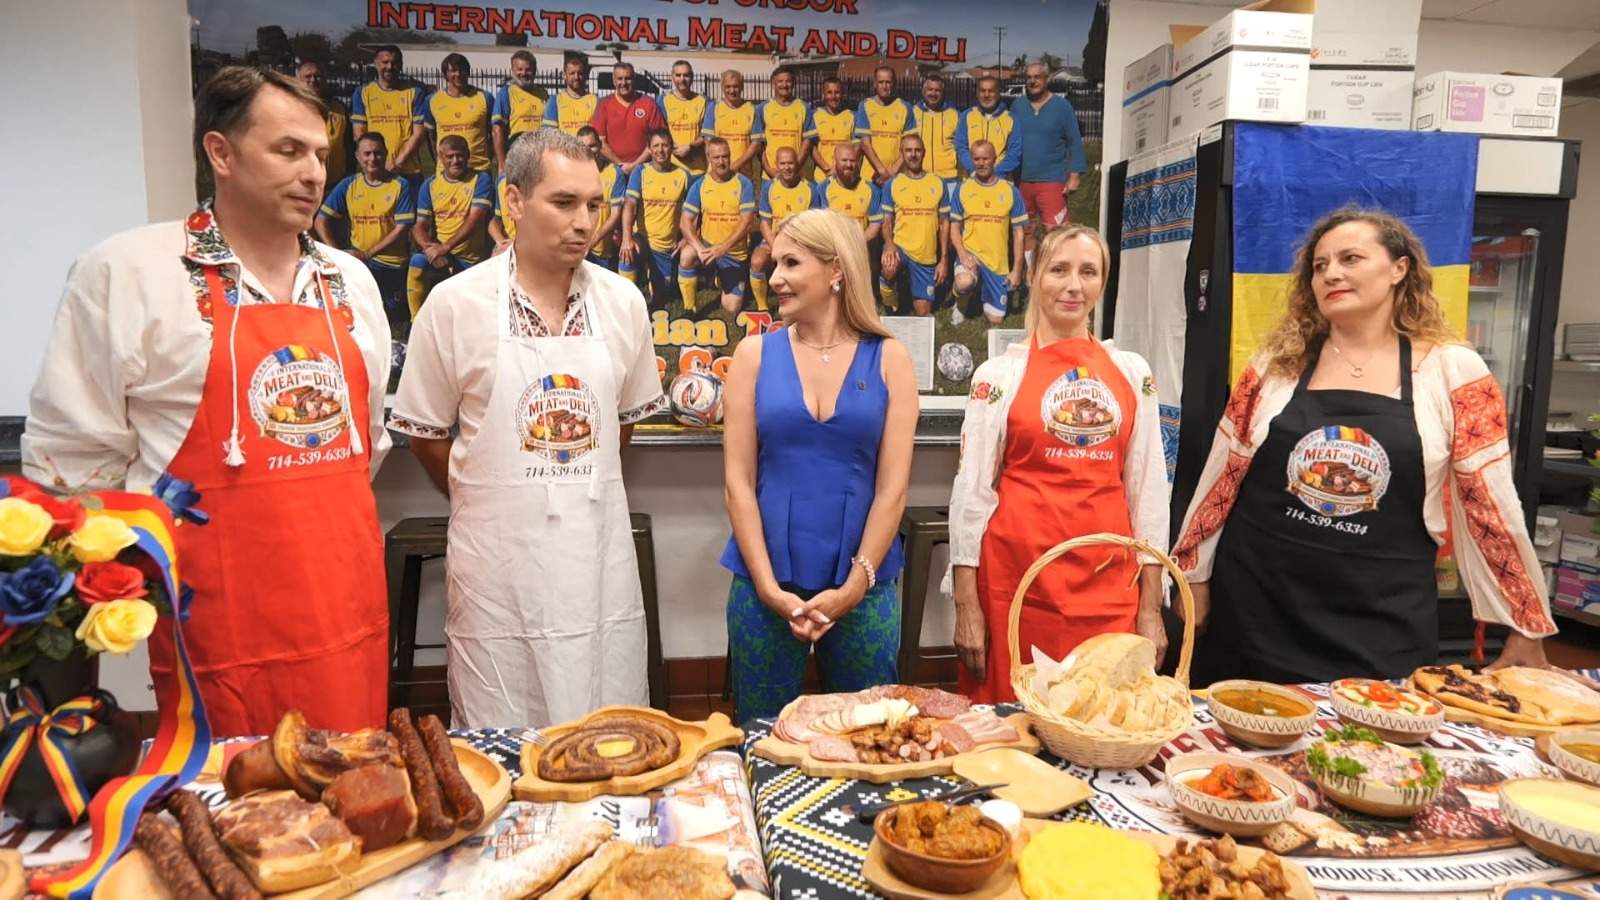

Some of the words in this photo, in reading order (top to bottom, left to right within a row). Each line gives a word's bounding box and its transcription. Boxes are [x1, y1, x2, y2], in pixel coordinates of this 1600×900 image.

[366, 0, 680, 46] INTERNATIONAL
[687, 16, 795, 51] MEAT
[800, 28, 879, 57] AND
[886, 28, 968, 63] DELI
[263, 372, 301, 398] MEAT
[313, 372, 338, 391] DELI
[525, 465, 593, 478] 714-539-633
[1303, 448, 1341, 462] MEAT
[1352, 453, 1378, 474] DELI
[1286, 507, 1368, 535] 714-539-6334
[1305, 864, 1402, 883] RODUSE
